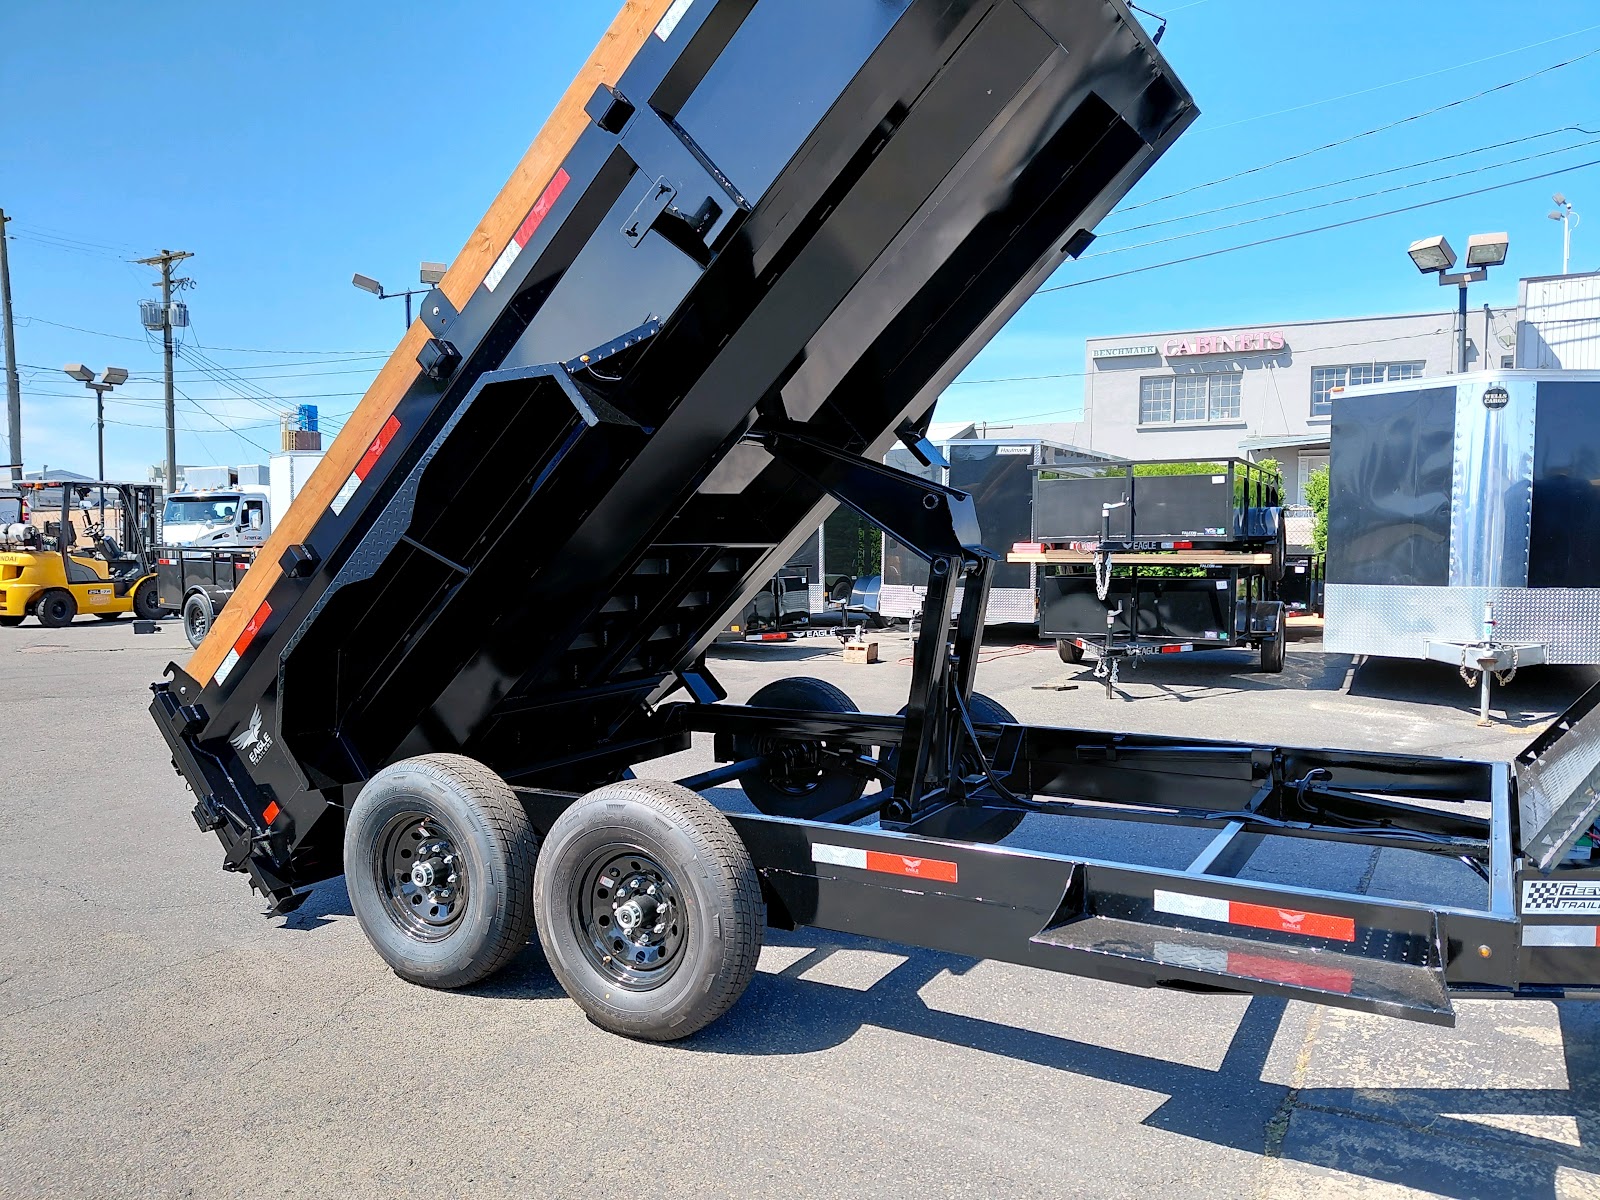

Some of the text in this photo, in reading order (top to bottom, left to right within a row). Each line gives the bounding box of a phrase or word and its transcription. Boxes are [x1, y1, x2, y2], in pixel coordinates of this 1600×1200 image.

[1093, 331, 1285, 357] BENCHMARK CABINETS
[1133, 541, 1157, 550] EAGLE
[806, 630, 836, 638] EAGLE
[249, 731, 271, 763] EAGLE
[252, 739, 274, 767] TRAILERS
[1561, 901, 1600, 909] TRAIL
